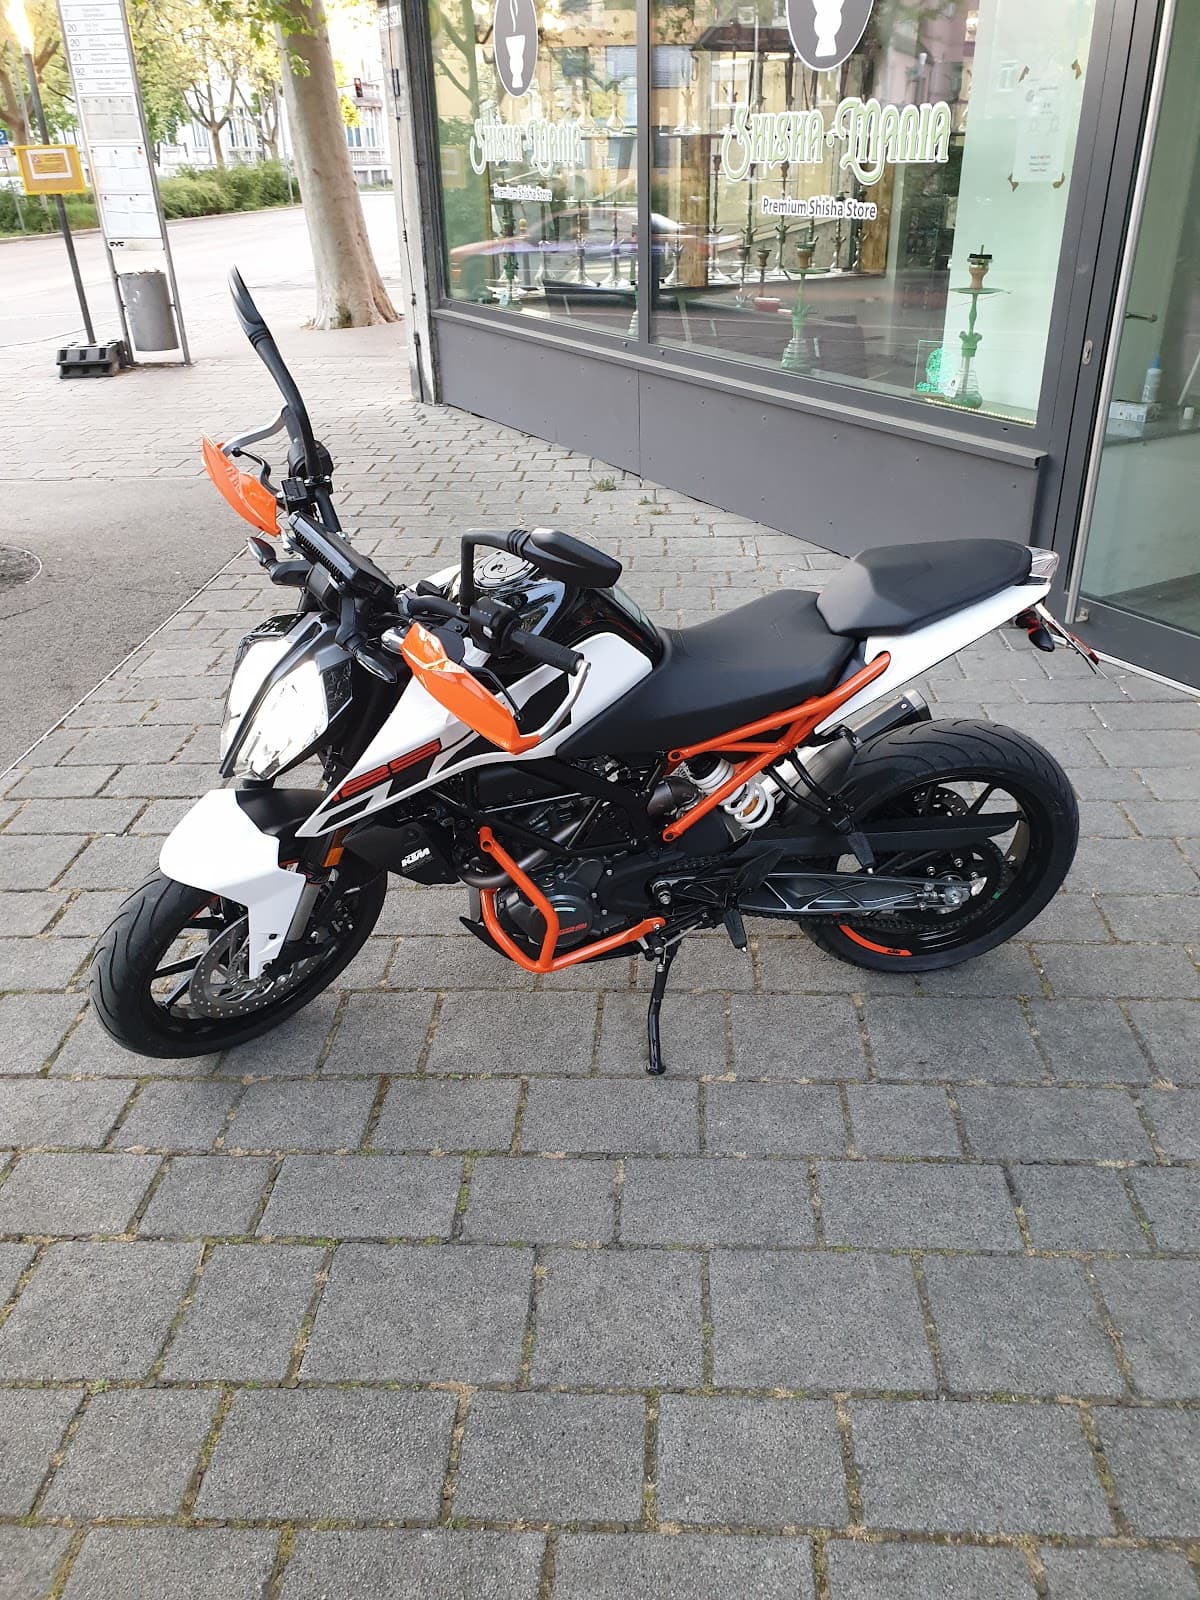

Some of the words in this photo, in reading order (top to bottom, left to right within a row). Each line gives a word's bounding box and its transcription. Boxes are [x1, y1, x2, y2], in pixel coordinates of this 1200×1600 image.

[67, 24, 77, 32] 20
[763, 198, 807, 215] Premium
[809, 199, 844, 217] Shisha
[846, 201, 877, 219] Store
[401, 847, 431, 867] KTM
